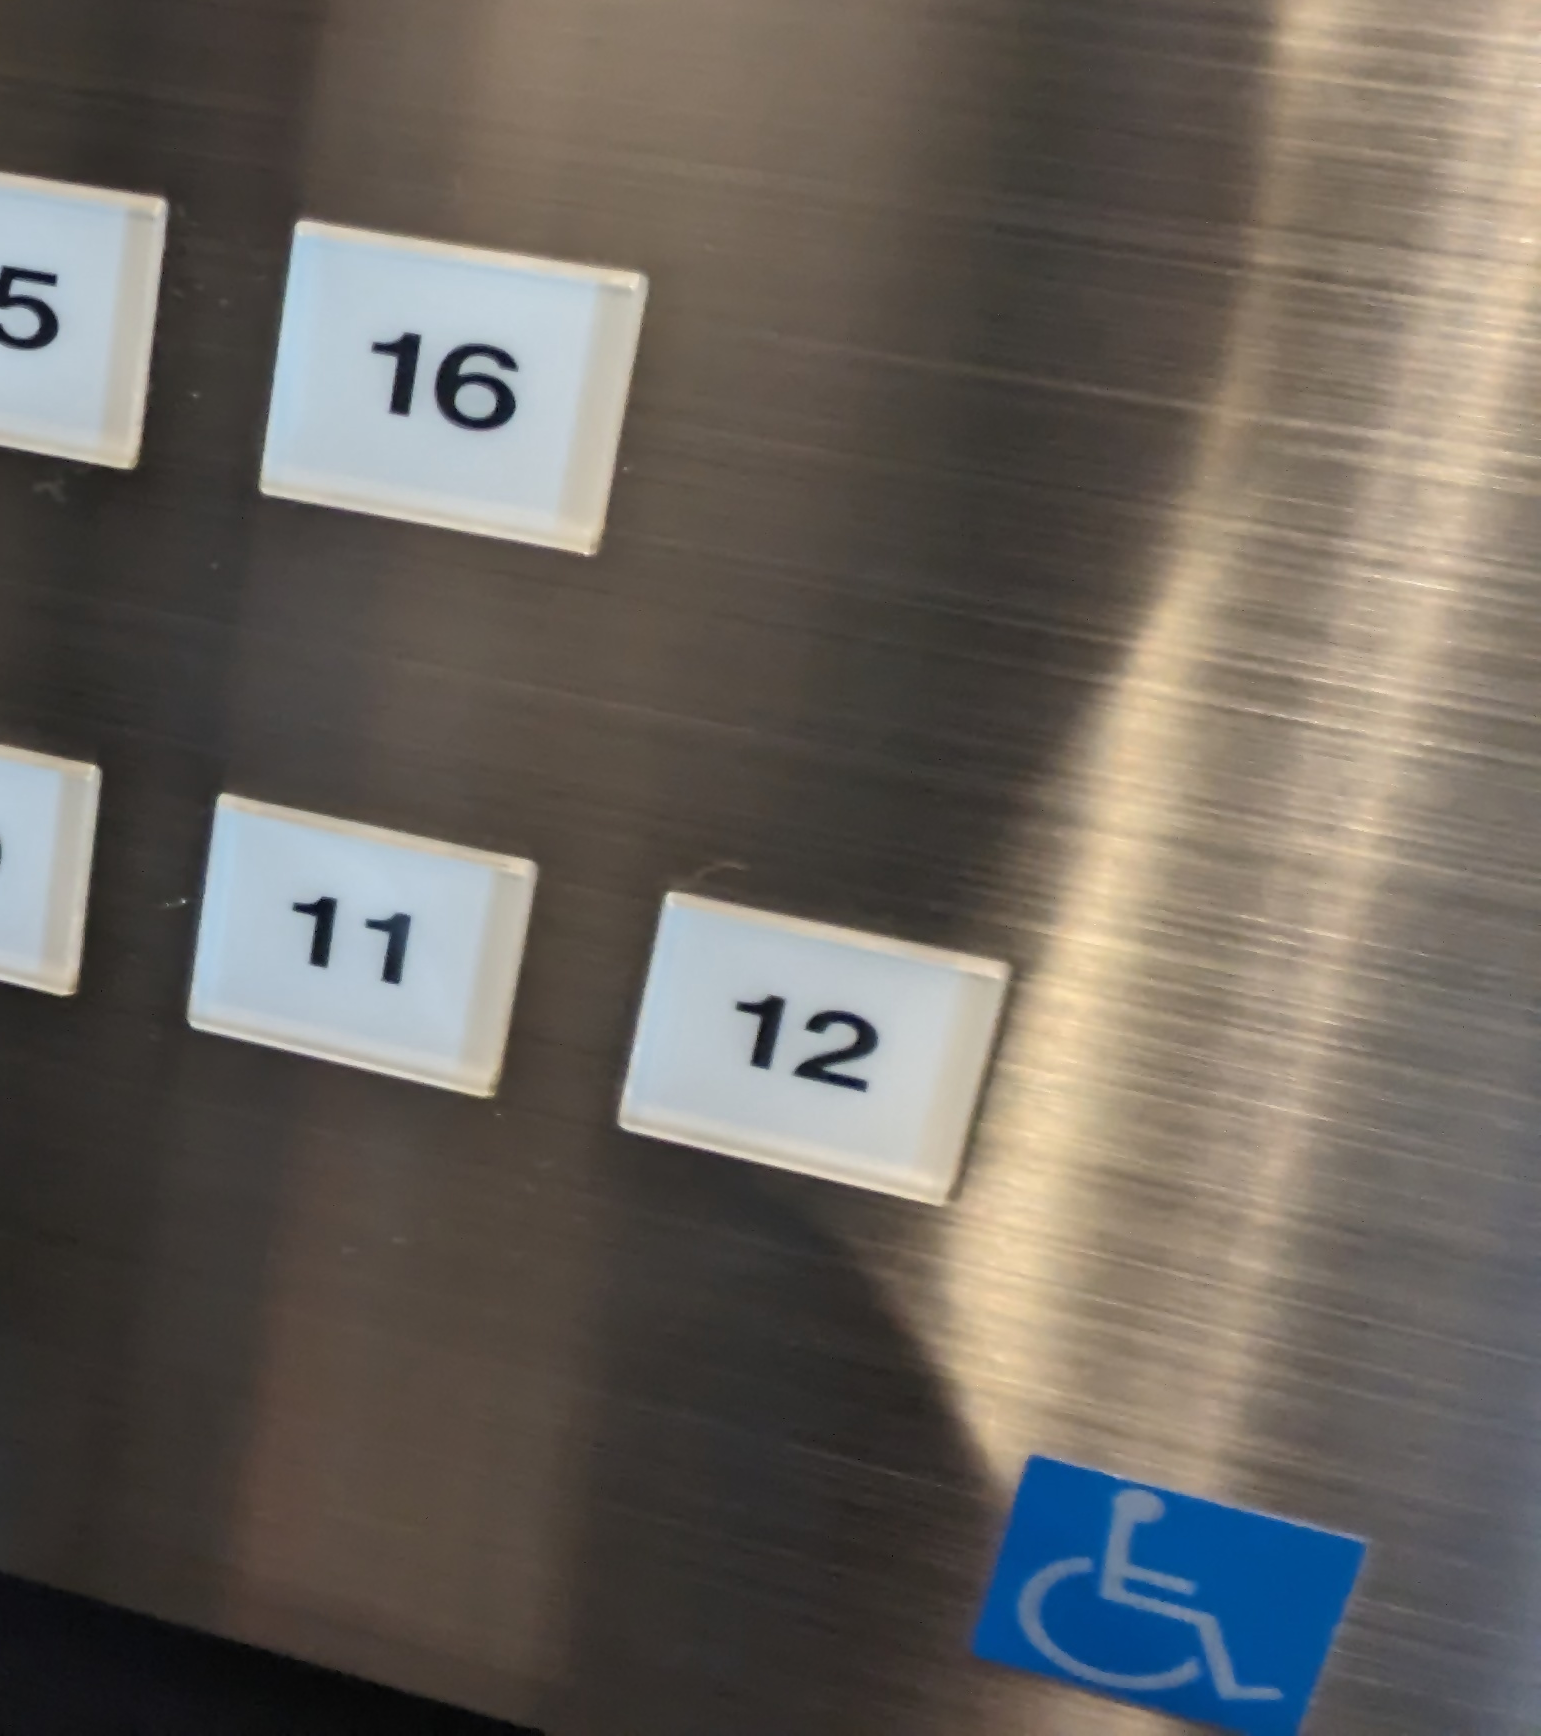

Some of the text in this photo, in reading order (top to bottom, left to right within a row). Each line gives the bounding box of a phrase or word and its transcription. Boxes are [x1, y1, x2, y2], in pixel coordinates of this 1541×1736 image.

[371, 332, 519, 431] 16
[292, 896, 411, 985] 11
[735, 994, 879, 1093] 12
